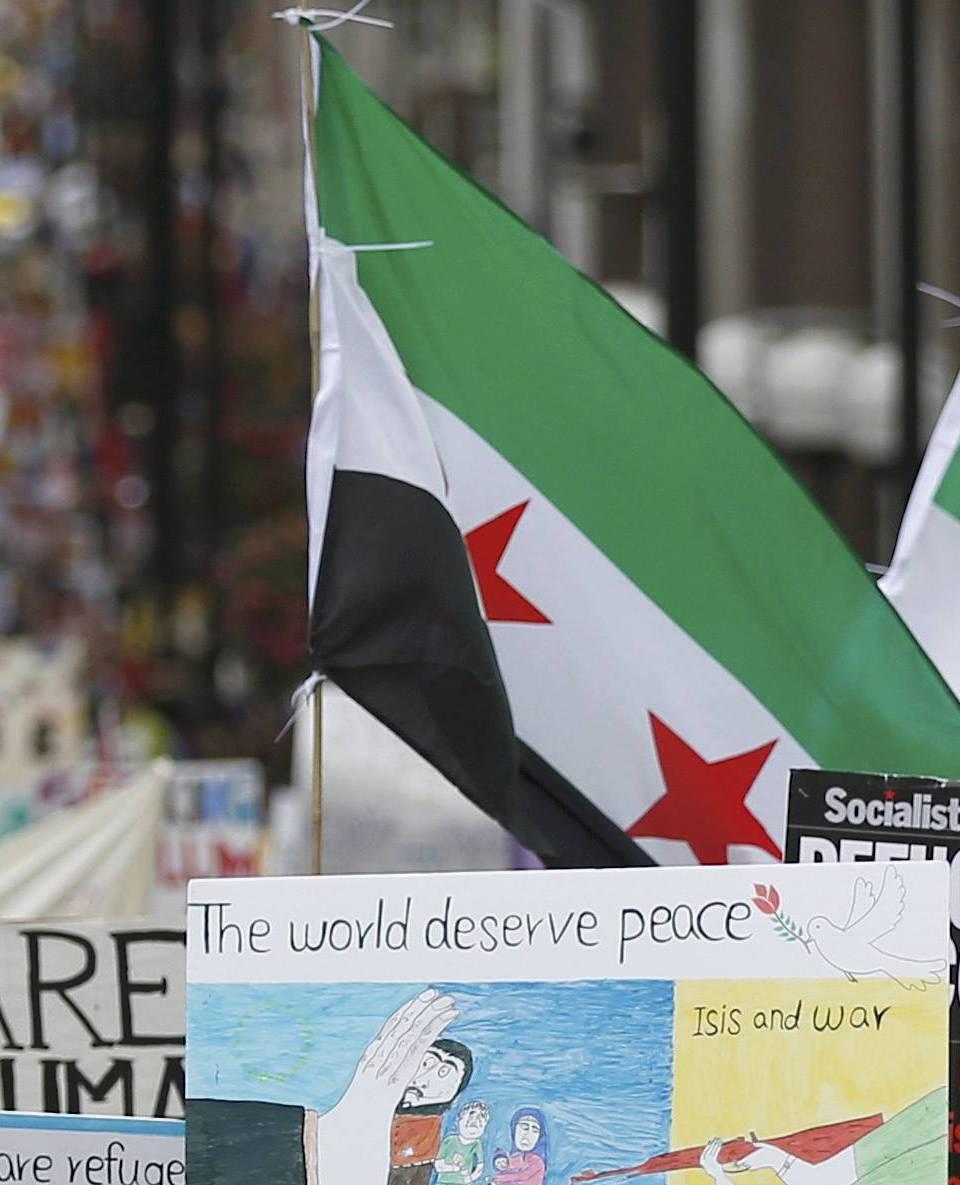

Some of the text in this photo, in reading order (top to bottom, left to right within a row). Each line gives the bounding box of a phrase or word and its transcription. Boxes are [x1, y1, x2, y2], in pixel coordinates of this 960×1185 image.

[187, 896, 752, 964] The world deserve peace
[0, 929, 186, 1049] RE
[692, 999, 891, 1037] Isis and war
[0, 1154, 52, 1183] are
